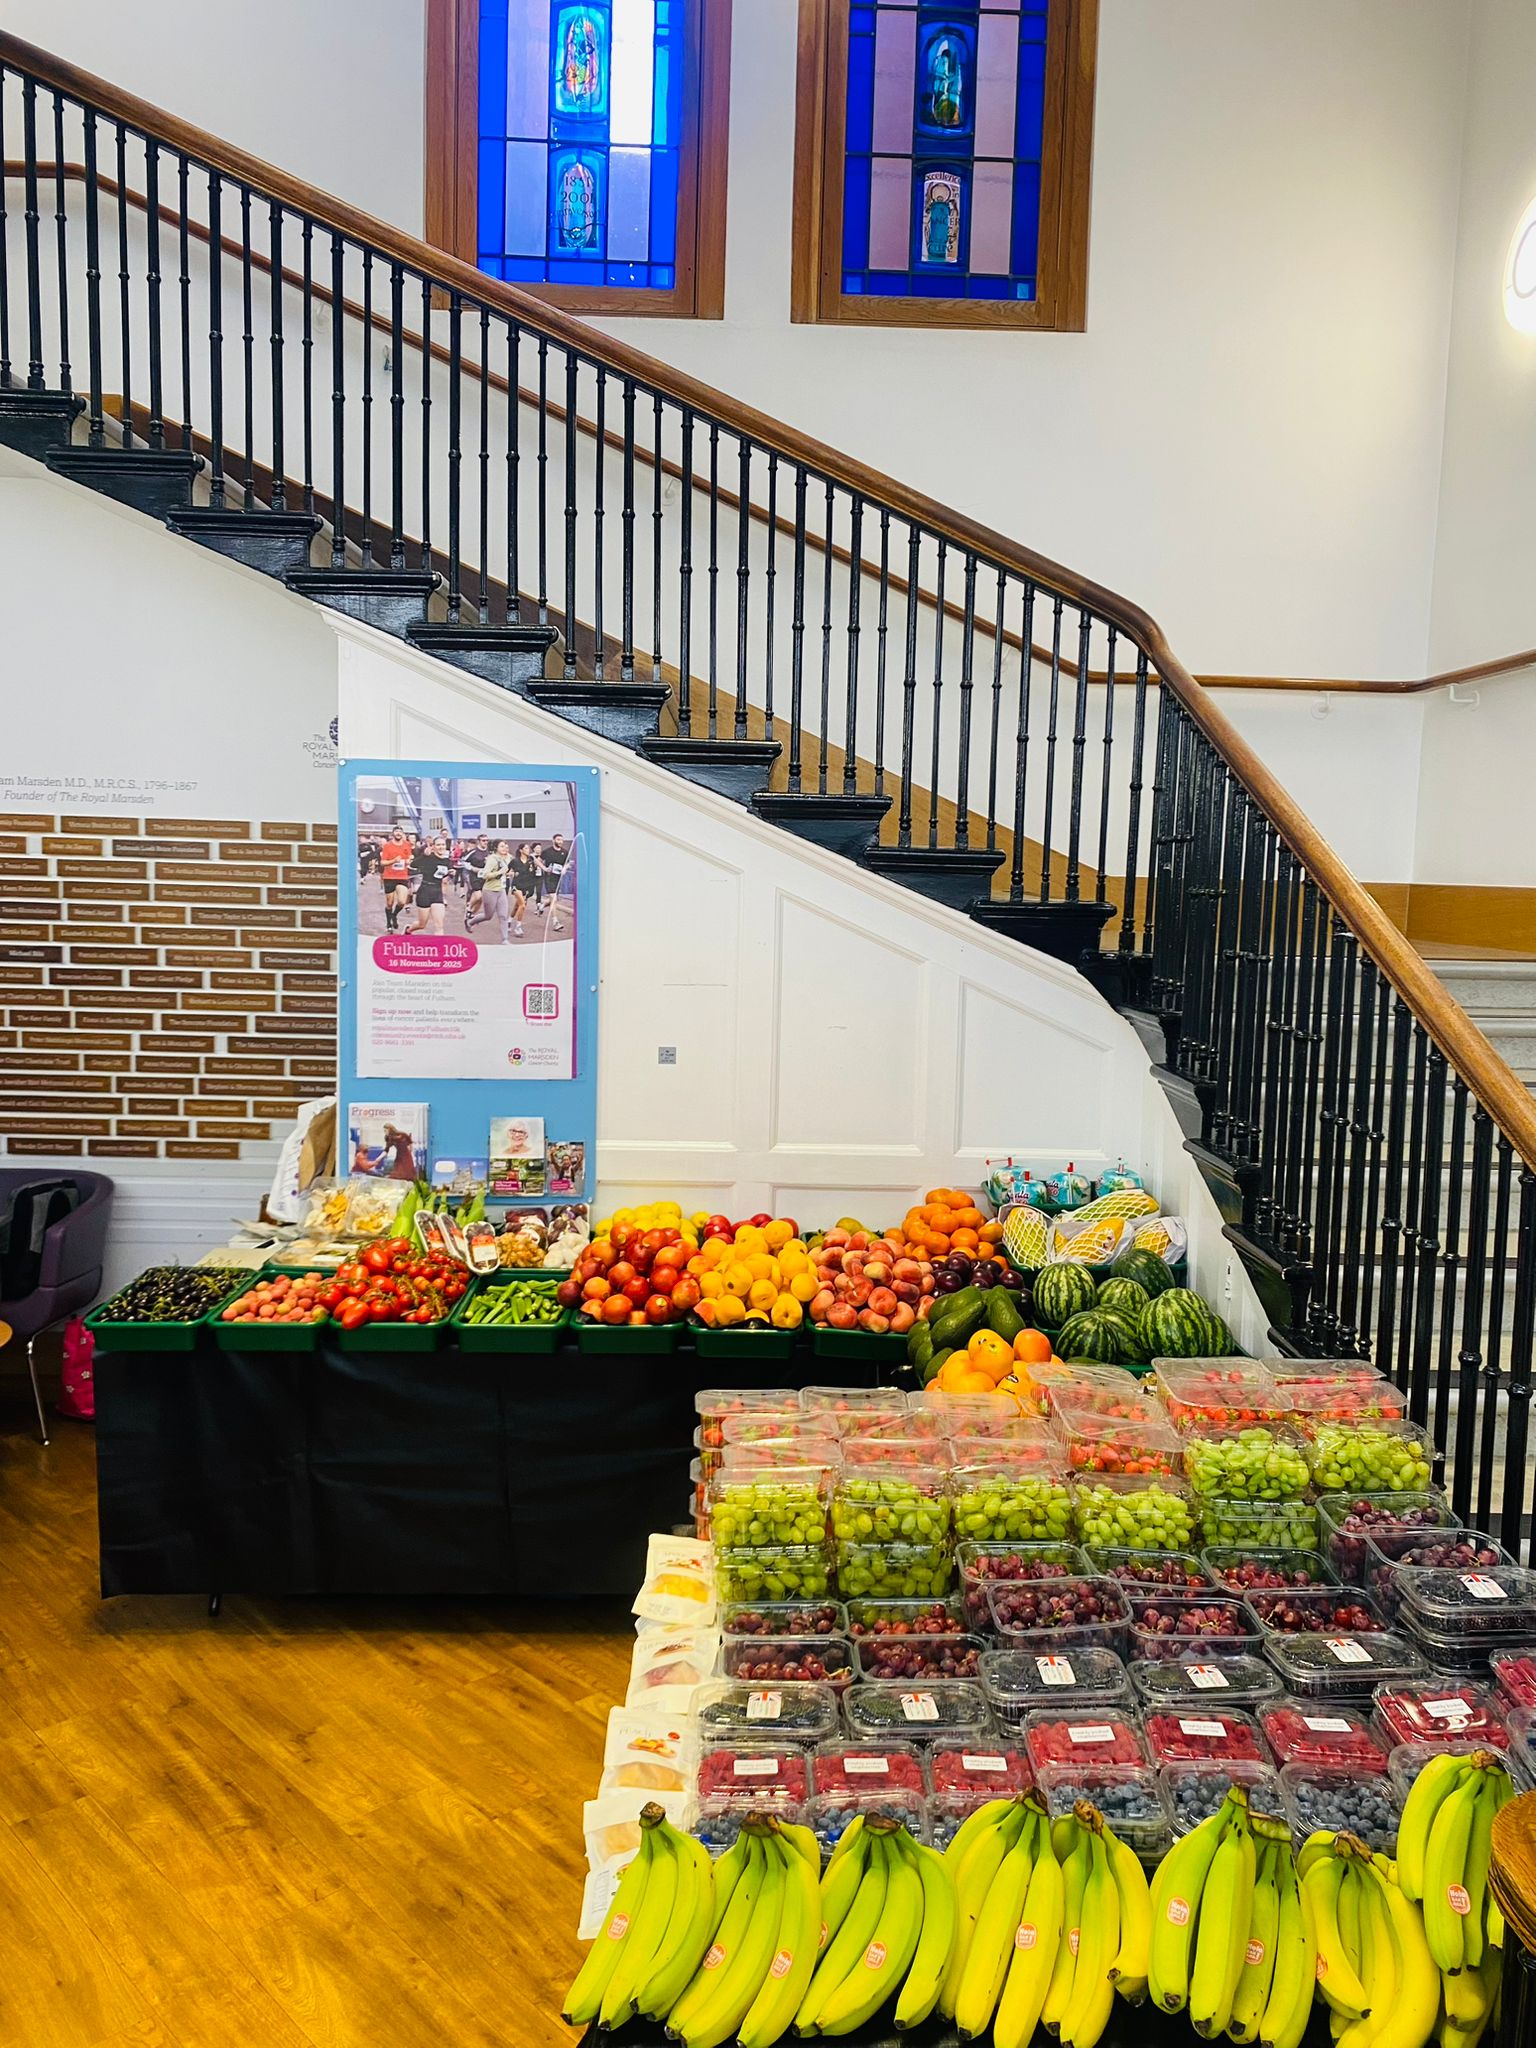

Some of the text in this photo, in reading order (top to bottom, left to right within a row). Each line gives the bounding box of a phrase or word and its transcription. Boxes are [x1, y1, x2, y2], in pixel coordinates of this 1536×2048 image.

[560, 191, 594, 203] 2001
[303, 742, 335, 752] ROYAL
[17, 776, 62, 787] Marsden
[65, 778, 91, 788] M.D.,
[94, 779, 141, 790] M.R.C.S.,
[4, 790, 155, 804] Founder of The Royal Marsden
[383, 942, 467, 958] Fulham 10k
[388, 959, 397, 967] 16
[400, 959, 441, 967] November
[351, 1106, 395, 1118] Progress
